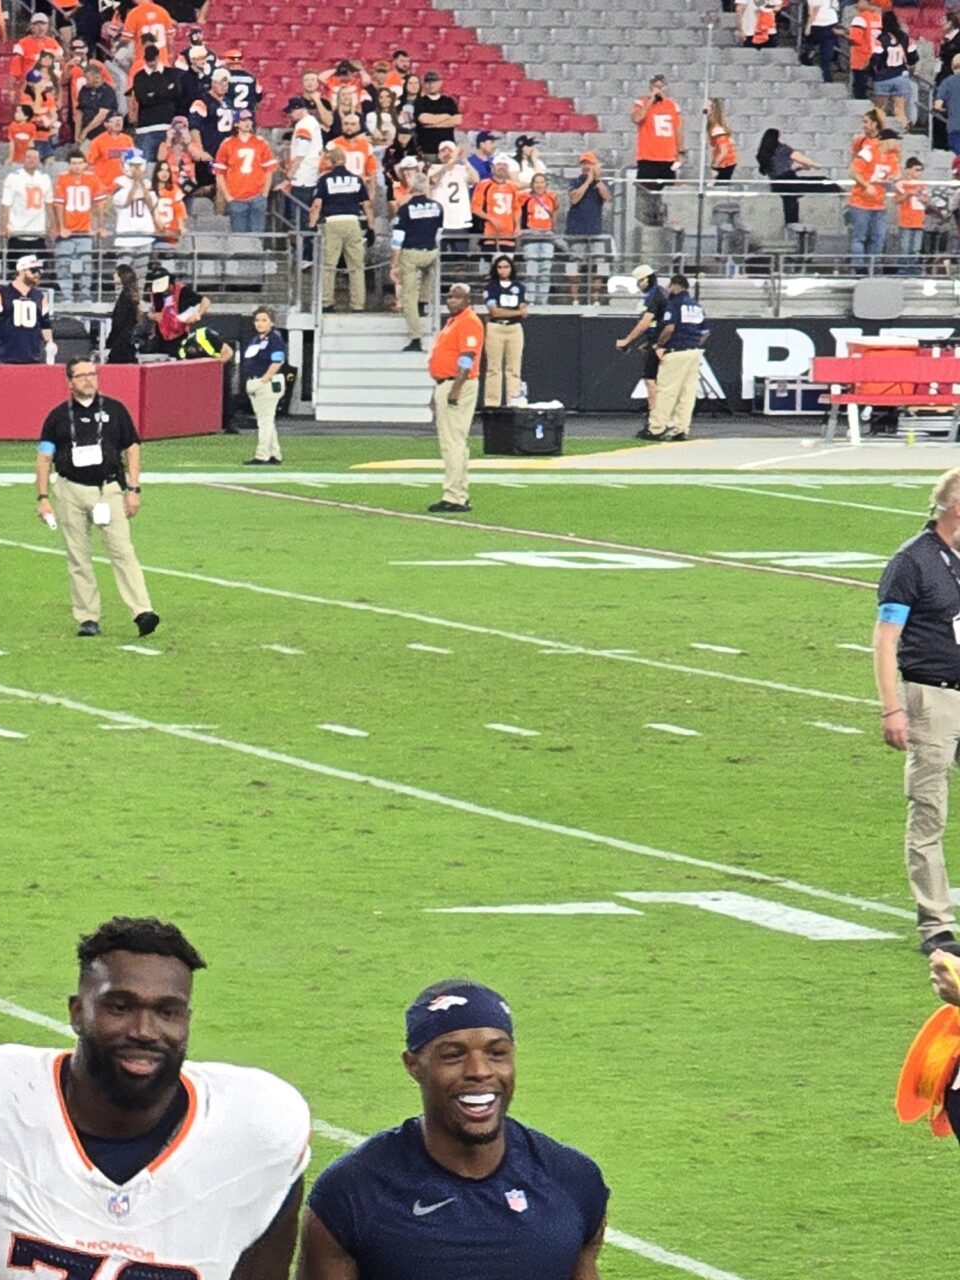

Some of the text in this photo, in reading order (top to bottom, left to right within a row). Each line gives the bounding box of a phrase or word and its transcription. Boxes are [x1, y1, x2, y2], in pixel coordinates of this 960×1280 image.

[234, 84, 249, 108] 2
[654, 115, 673, 137] 15
[238, 148, 255, 174] 7
[66, 185, 91, 212] 10
[448, 183, 460, 204] 2
[130, 200, 145, 218] 10
[13, 299, 37, 328] 10
